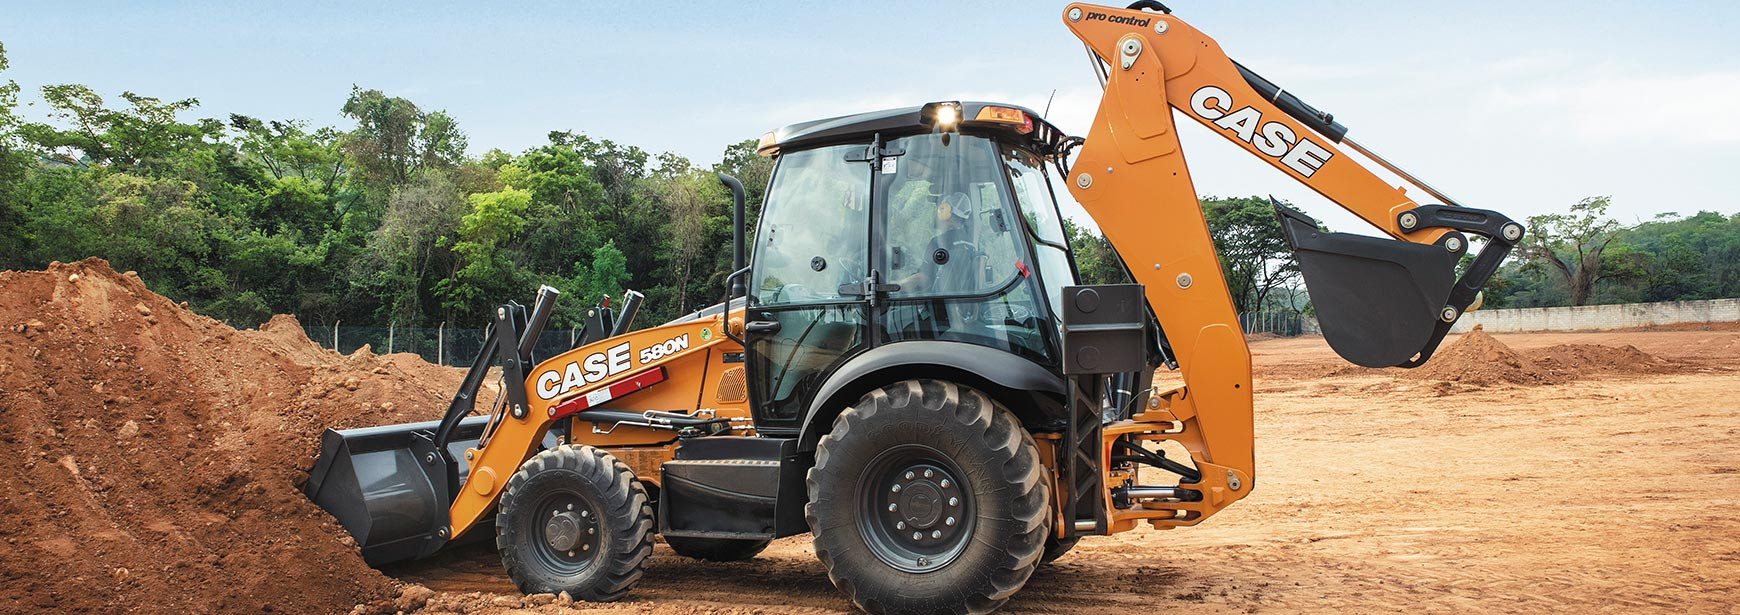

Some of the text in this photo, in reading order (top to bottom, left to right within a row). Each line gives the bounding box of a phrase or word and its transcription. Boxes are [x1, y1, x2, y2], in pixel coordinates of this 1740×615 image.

[1086, 11, 1151, 27] pro control
[1190, 85, 1333, 178] CASE
[536, 333, 690, 400] CASE 580N
